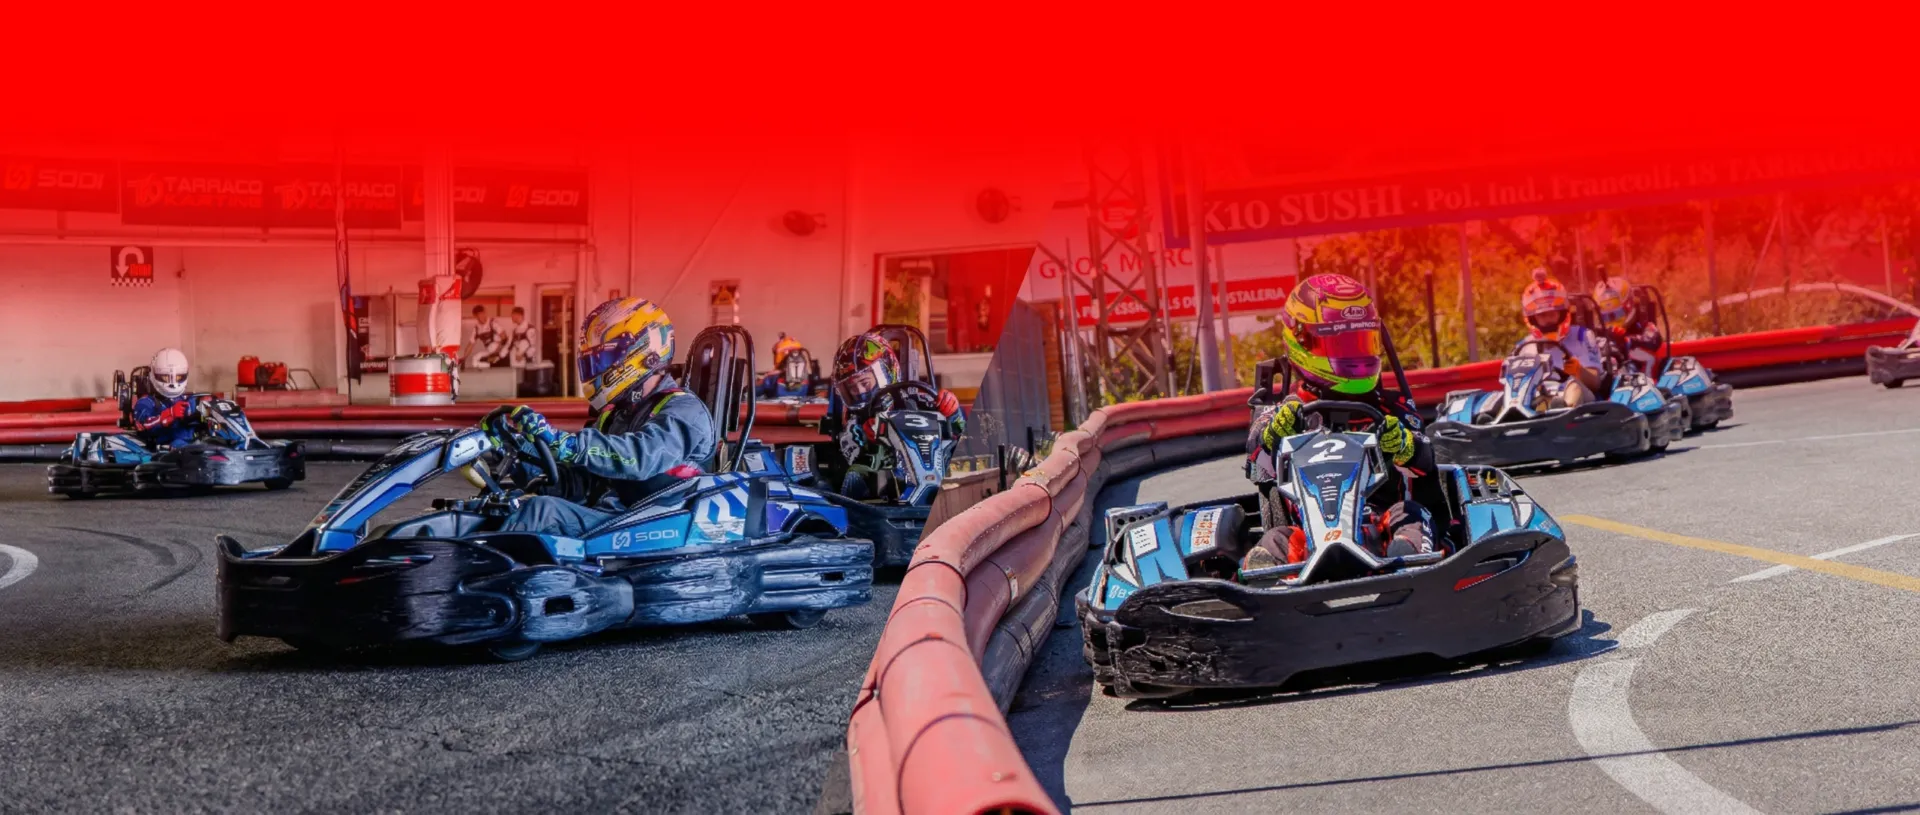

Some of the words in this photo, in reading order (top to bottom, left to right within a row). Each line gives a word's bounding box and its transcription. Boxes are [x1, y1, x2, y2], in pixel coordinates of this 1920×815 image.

[38, 169, 104, 190] SODI
[163, 175, 264, 195] TARRACO
[307, 180, 396, 198] TARACO
[529, 189, 580, 207] SODI
[1280, 183, 1405, 227] SUSHI
[1425, 183, 1480, 211] Pol.
[1487, 176, 1545, 206] Ind.
[904, 414, 930, 428] 3
[1307, 439, 1347, 463] 2
[635, 529, 679, 542] SODI
